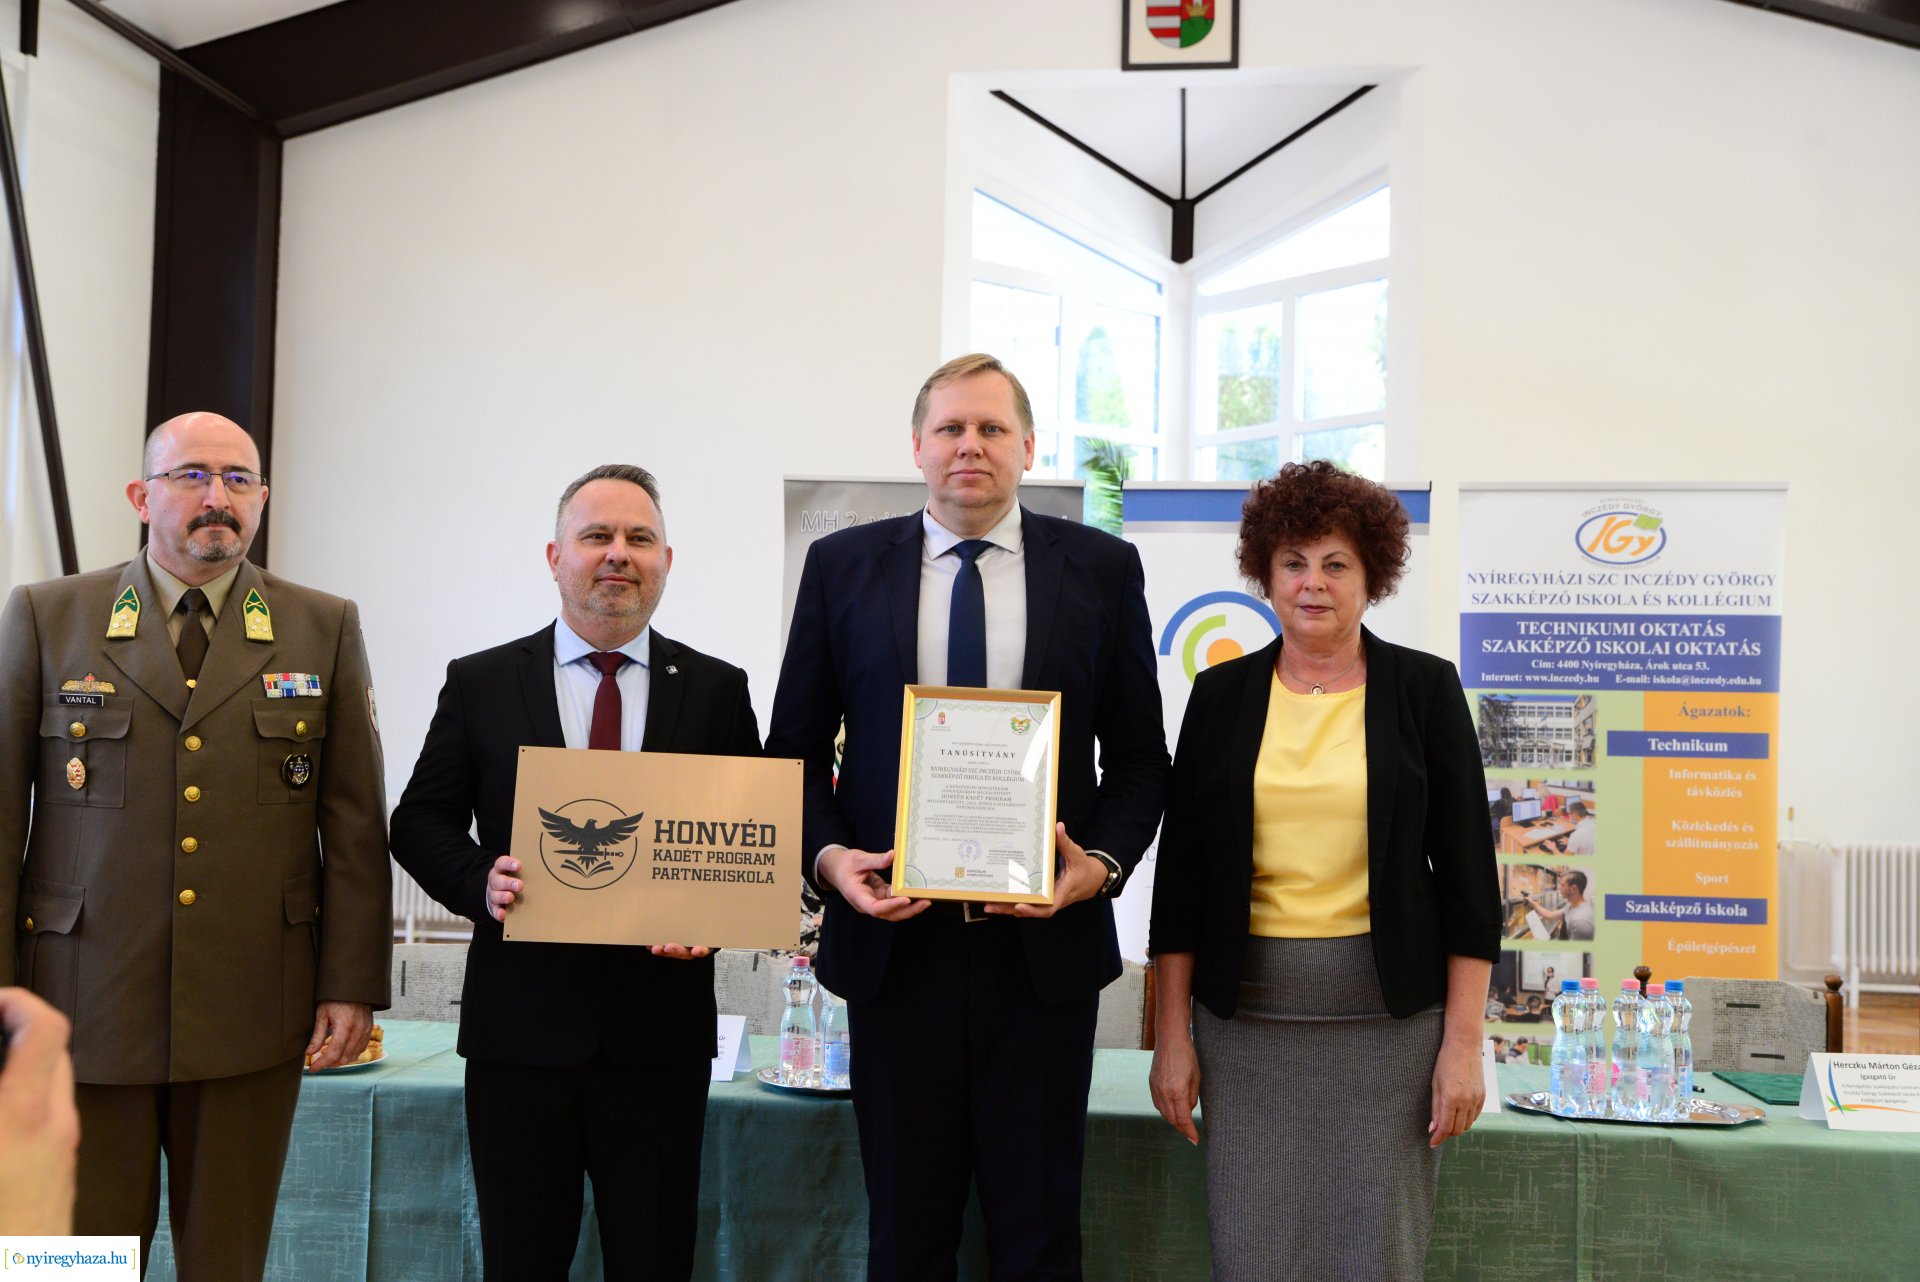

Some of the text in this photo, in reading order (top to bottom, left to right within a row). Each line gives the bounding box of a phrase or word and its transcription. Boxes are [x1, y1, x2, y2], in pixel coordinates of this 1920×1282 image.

[800, 510, 839, 532] MH
[1467, 570, 1777, 588] NYÍREGYHÁZI SZC INCZÉDY GYÖRGY
[1471, 590, 1772, 607] SZAKKÉPZŐ ISKOLA ÉS KOLLÉGIUM
[1517, 619, 1726, 637] TECHNIKUMI OKTATÁS
[1482, 636, 1761, 656] SZAKKÉPZŐ ISKOLAI OKTATÁS
[1531, 659, 1710, 673] Cím: 4400 Nyíregyháza, Árok utca 53.
[1481, 673, 1762, 687] Internet: www.inczedy.hu E-mail: iskola@inczedy.edu.hu
[66, 696, 97, 705] VANTAL
[1679, 702, 1751, 720] Ágazatok:
[1648, 738, 1728, 752] Technikum
[940, 749, 1016, 759] TANÚSÍTVÁNY
[1669, 768, 1757, 782] Informatika és
[1687, 785, 1743, 798] távközlés
[654, 818, 776, 848] HONVÉD
[1671, 819, 1754, 833] Közlekedés és
[1665, 837, 1760, 853] szállítmányozás
[653, 848, 776, 866] KADÉT PROGRAM
[652, 867, 775, 884] PARTNERISKOLA
[1695, 872, 1729, 886] Sport
[1626, 900, 1748, 917] Szakképző iskola
[1667, 940, 1757, 957] Épületgépészet
[1833, 1061, 1866, 1069] Herczku
[1868, 1062, 1900, 1070] Márton
